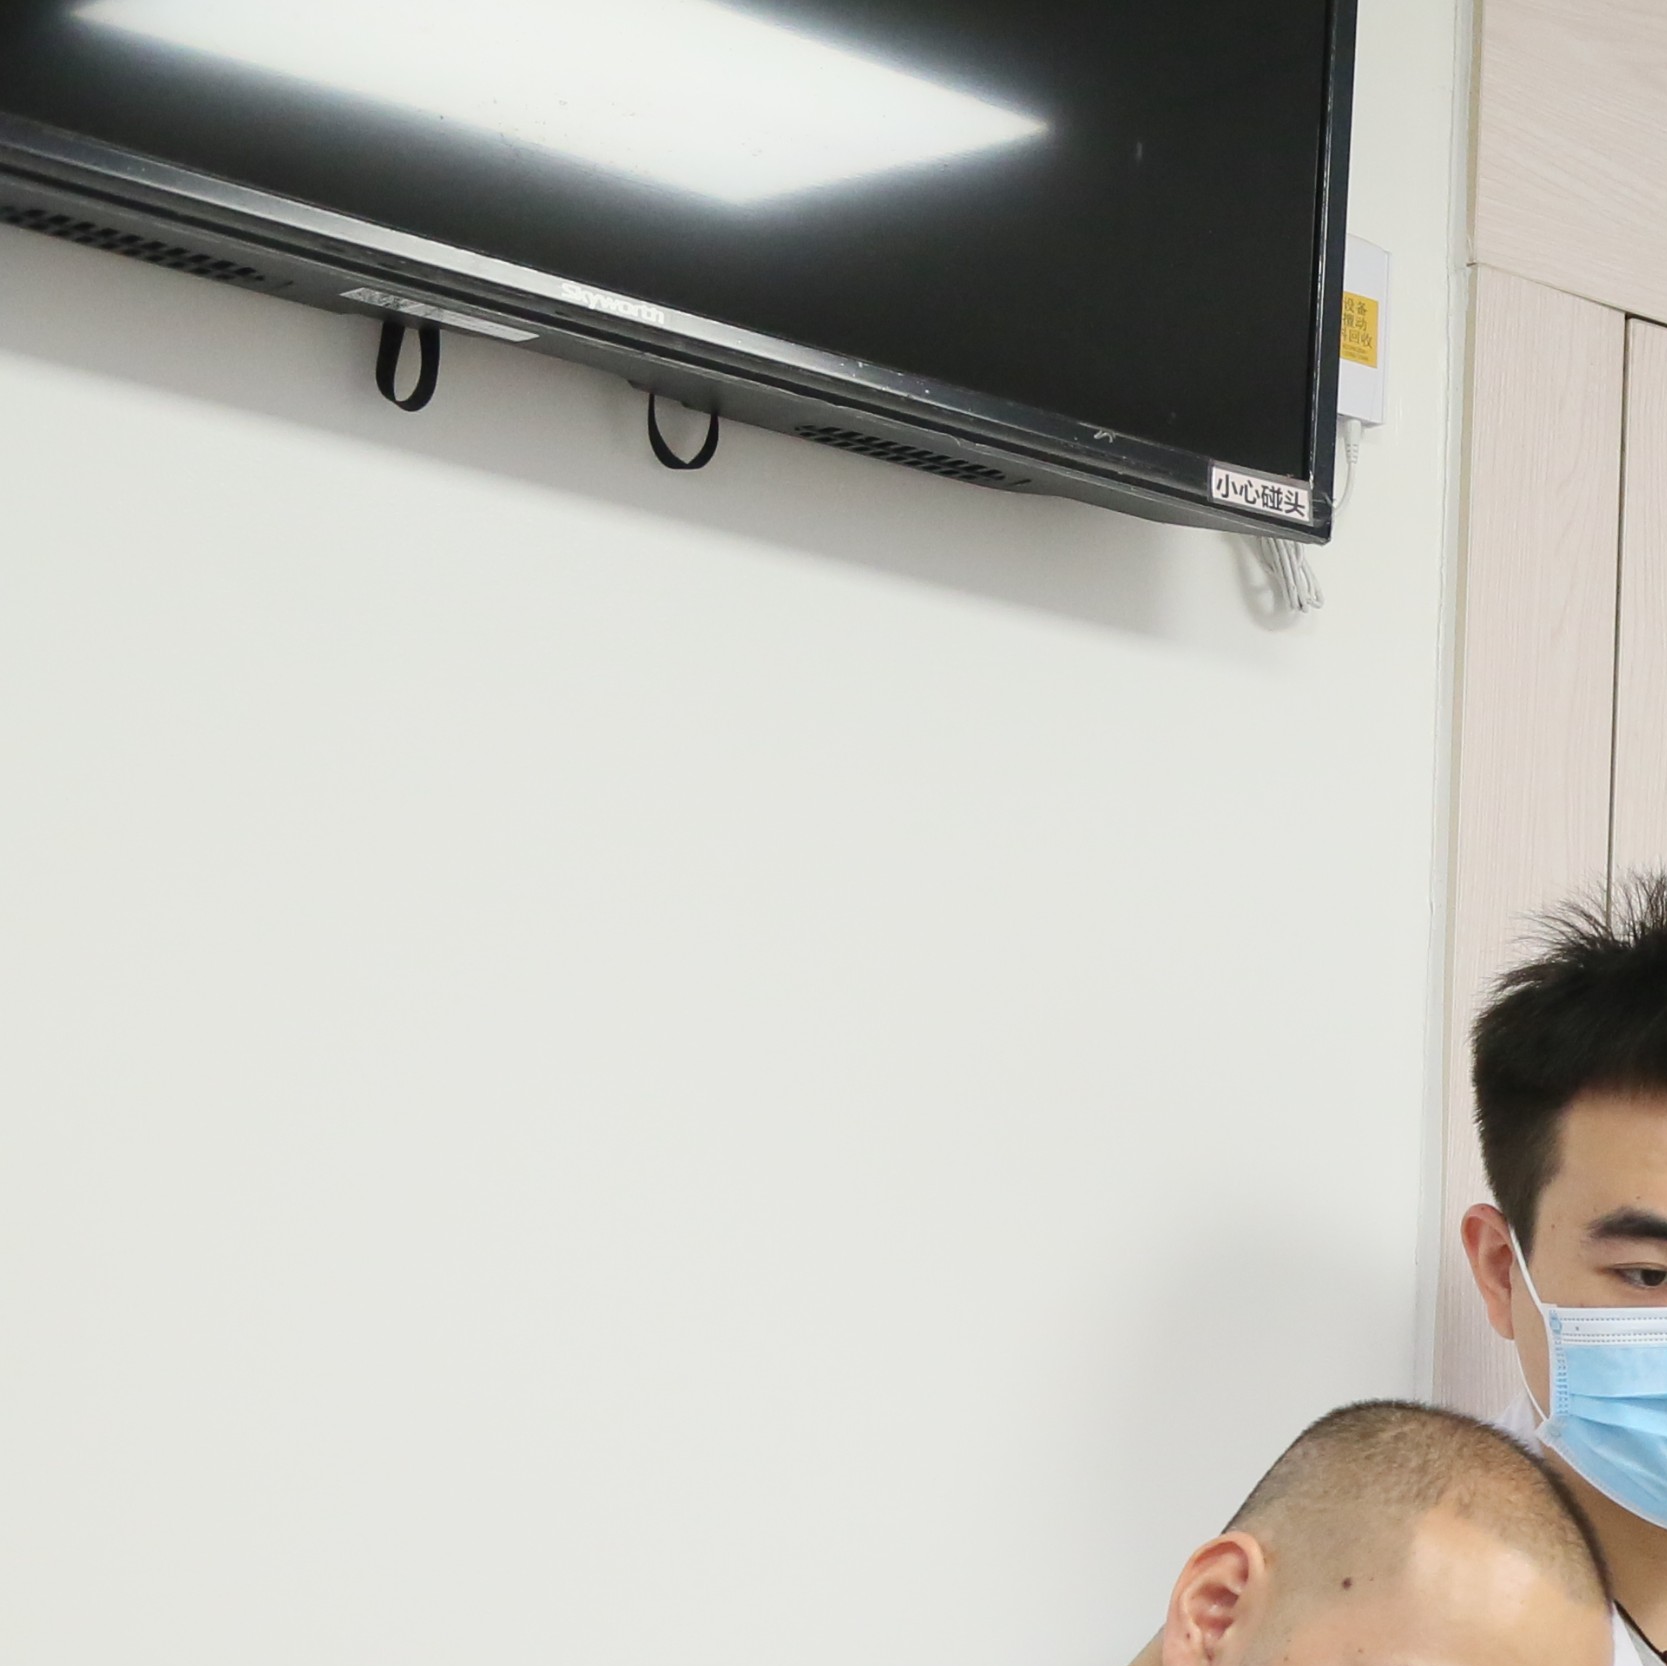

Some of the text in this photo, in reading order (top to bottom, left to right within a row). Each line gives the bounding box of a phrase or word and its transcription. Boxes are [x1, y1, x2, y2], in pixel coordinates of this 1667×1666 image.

[561, 282, 664, 325] Skyworth
[1216, 474, 1305, 517] 小心碰头
